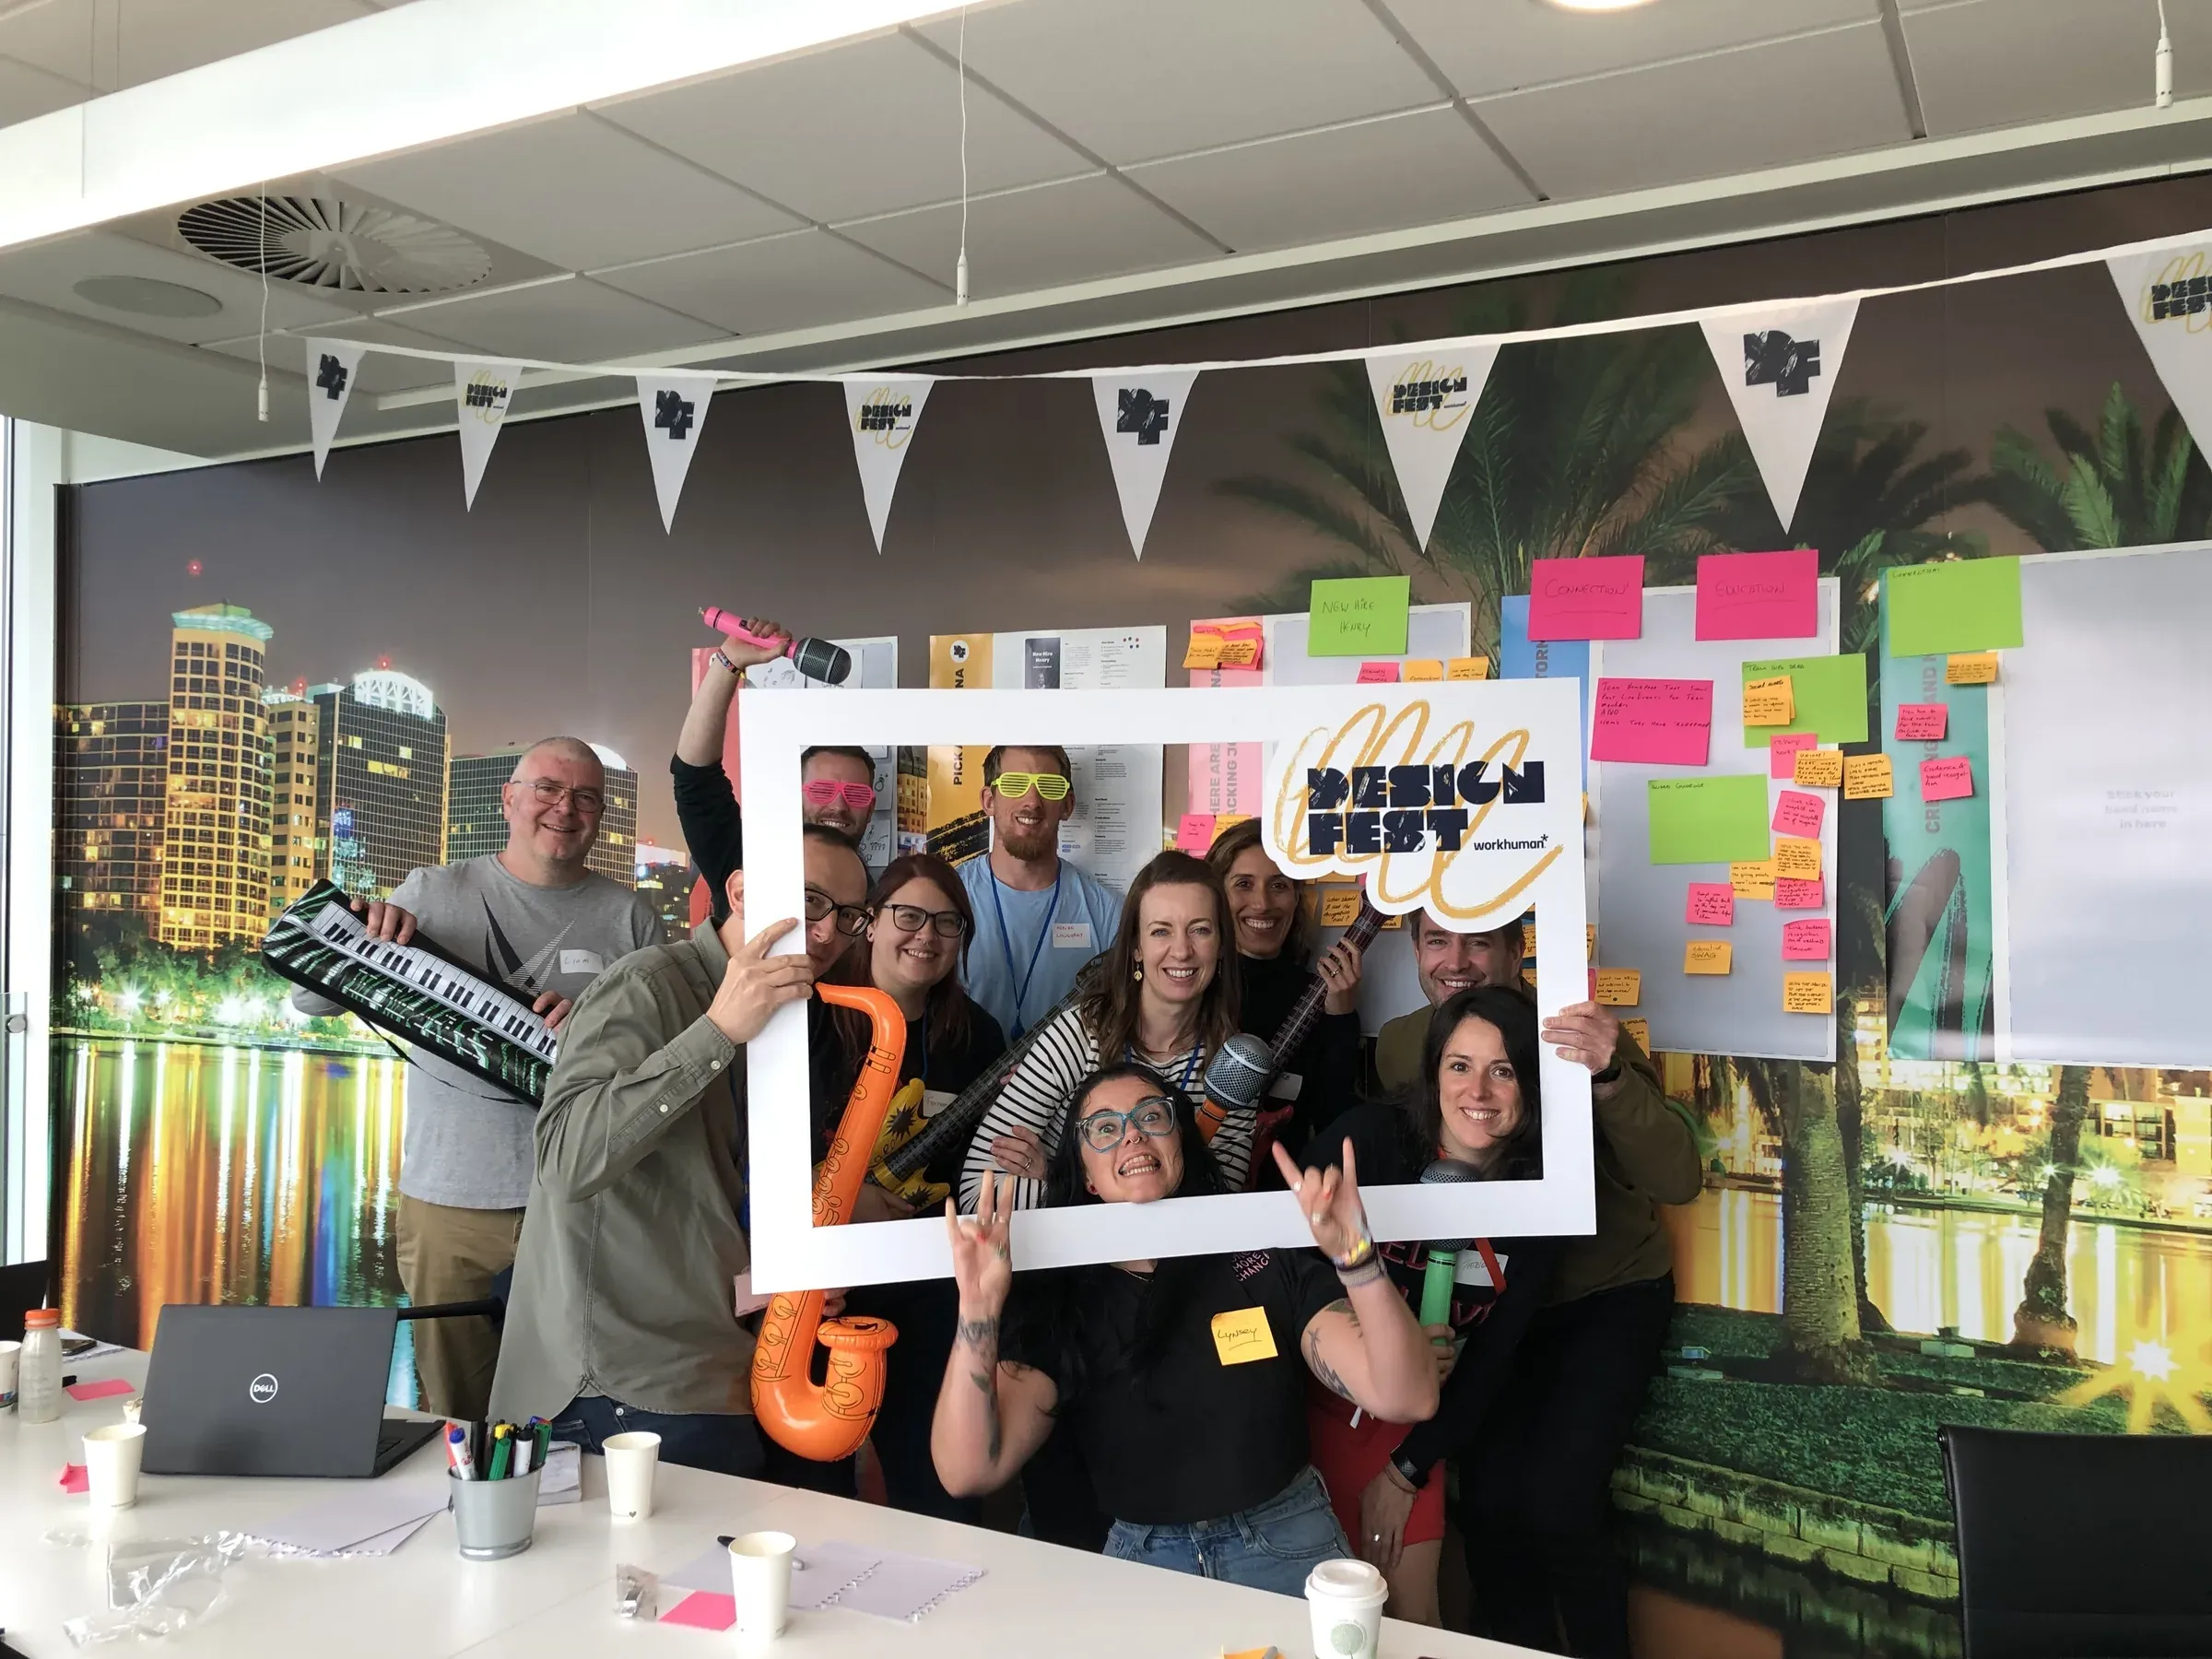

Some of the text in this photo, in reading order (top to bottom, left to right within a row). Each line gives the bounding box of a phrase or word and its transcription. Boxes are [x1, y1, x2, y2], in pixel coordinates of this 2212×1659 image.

[466, 383, 508, 398] DESIGN
[1393, 377, 1467, 399] DESIGN
[465, 395, 494, 407] FEST
[1392, 394, 1443, 414] FEST
[861, 404, 912, 418] DESIGN
[860, 417, 896, 430] FEST
[1322, 601, 1349, 614] NEW
[1339, 620, 1371, 638] HENRY
[1306, 760, 1546, 810] DESIGN
[1308, 808, 1468, 855] FEST
[1232, 1252, 1261, 1273] MORE
[253, 1384, 275, 1393] DELL
